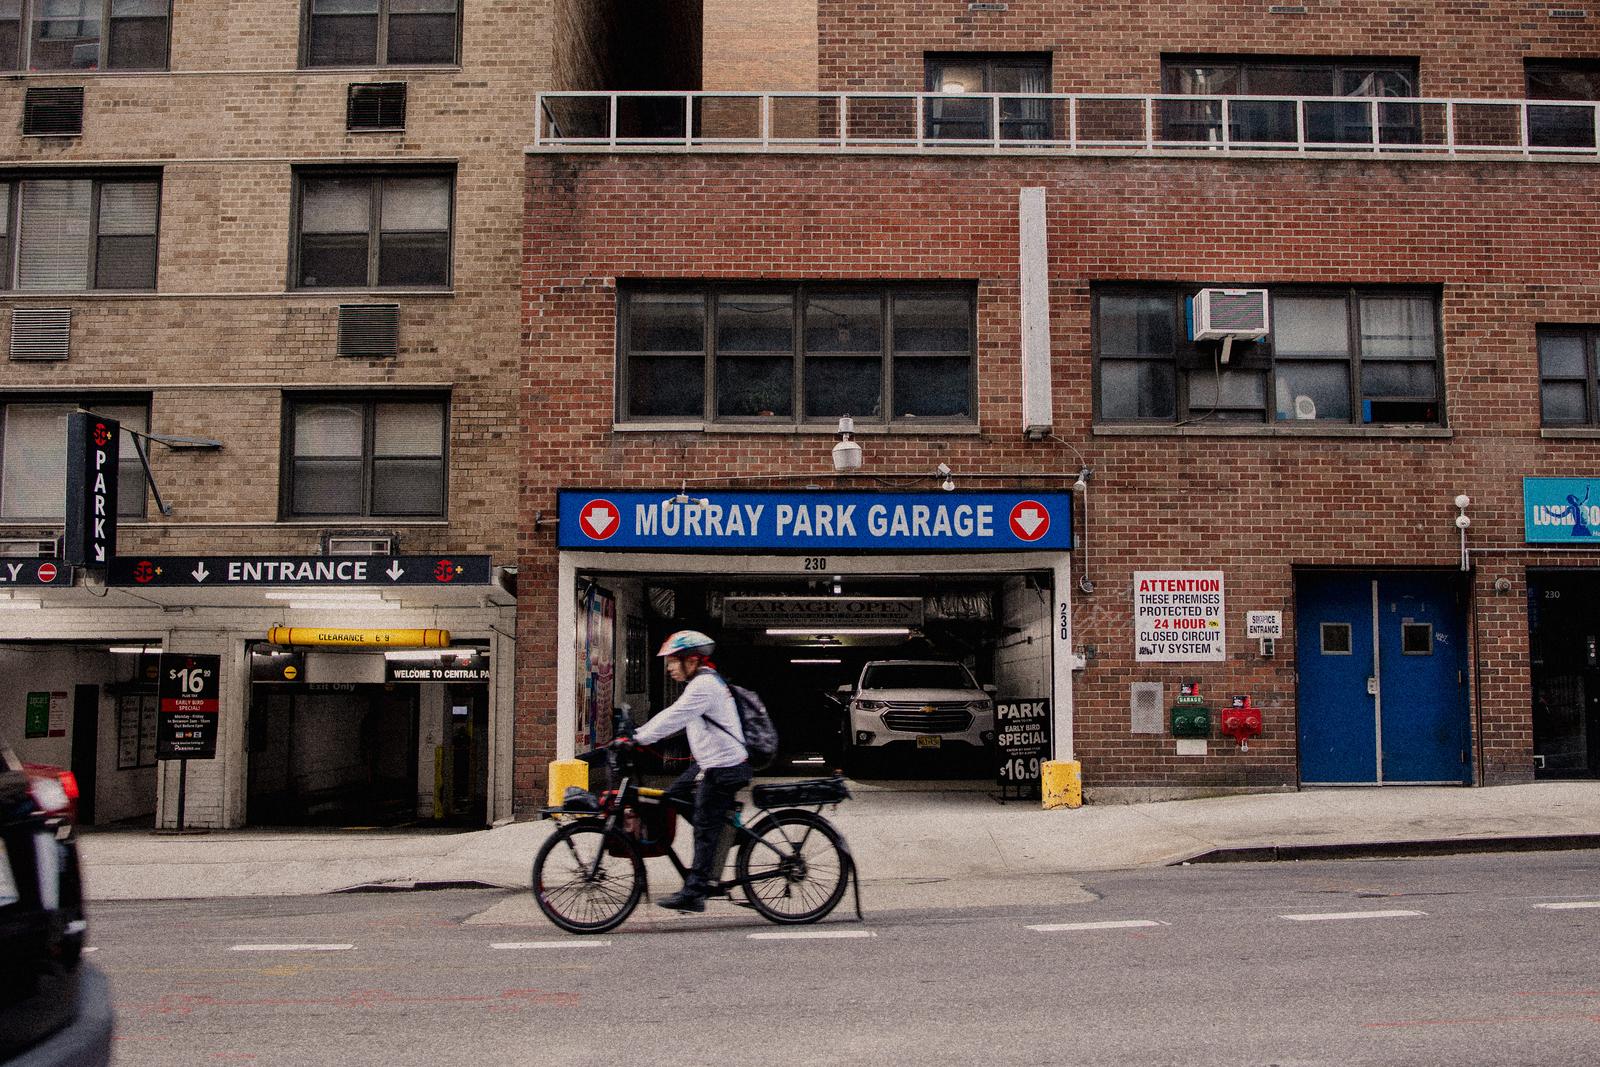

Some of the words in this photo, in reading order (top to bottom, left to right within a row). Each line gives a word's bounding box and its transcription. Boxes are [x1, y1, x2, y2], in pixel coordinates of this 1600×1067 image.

[94, 450, 106, 539] PARK
[635, 504, 764, 537] MURRAY
[776, 504, 856, 537] PARK
[868, 505, 994, 537] GARAGE
[804, 558, 826, 570] 230
[0, 563, 24, 582] Y
[228, 561, 367, 581] ENTRANCE
[1139, 579, 1220, 592] ATTENTION
[1140, 594, 1170, 604] THESE
[1172, 594, 1220, 604] PREMISES
[1545, 591, 1560, 599] 230
[731, 601, 839, 613] GARAGE
[846, 601, 914, 613] OPEN
[1139, 606, 1202, 617] PROTECTED
[1205, 606, 1220, 617] BY
[1060, 602, 1068, 640] 230
[1154, 618, 1169, 630] 24
[1173, 618, 1206, 630] HOUR
[1249, 625, 1279, 634] ENTRANCE
[318, 633, 364, 642] CLEARANCE
[1140, 631, 1179, 642] CLOSED
[1181, 631, 1220, 642] CIRCUIT
[1152, 643, 1165, 654] TV
[1168, 643, 1211, 654] SYSTEM
[394, 669, 430, 679] WELCOME
[432, 669, 443, 679] TO
[444, 669, 479, 679] CENTRAL
[309, 682, 329, 691] Exit
[333, 682, 356, 693] Only
[997, 702, 1046, 719] PARK
[1005, 724, 1025, 733] EARLY
[1025, 723, 1041, 731] BIRD
[998, 731, 1048, 747] SPECIAL
[1000, 757, 1048, 780] $16.9
